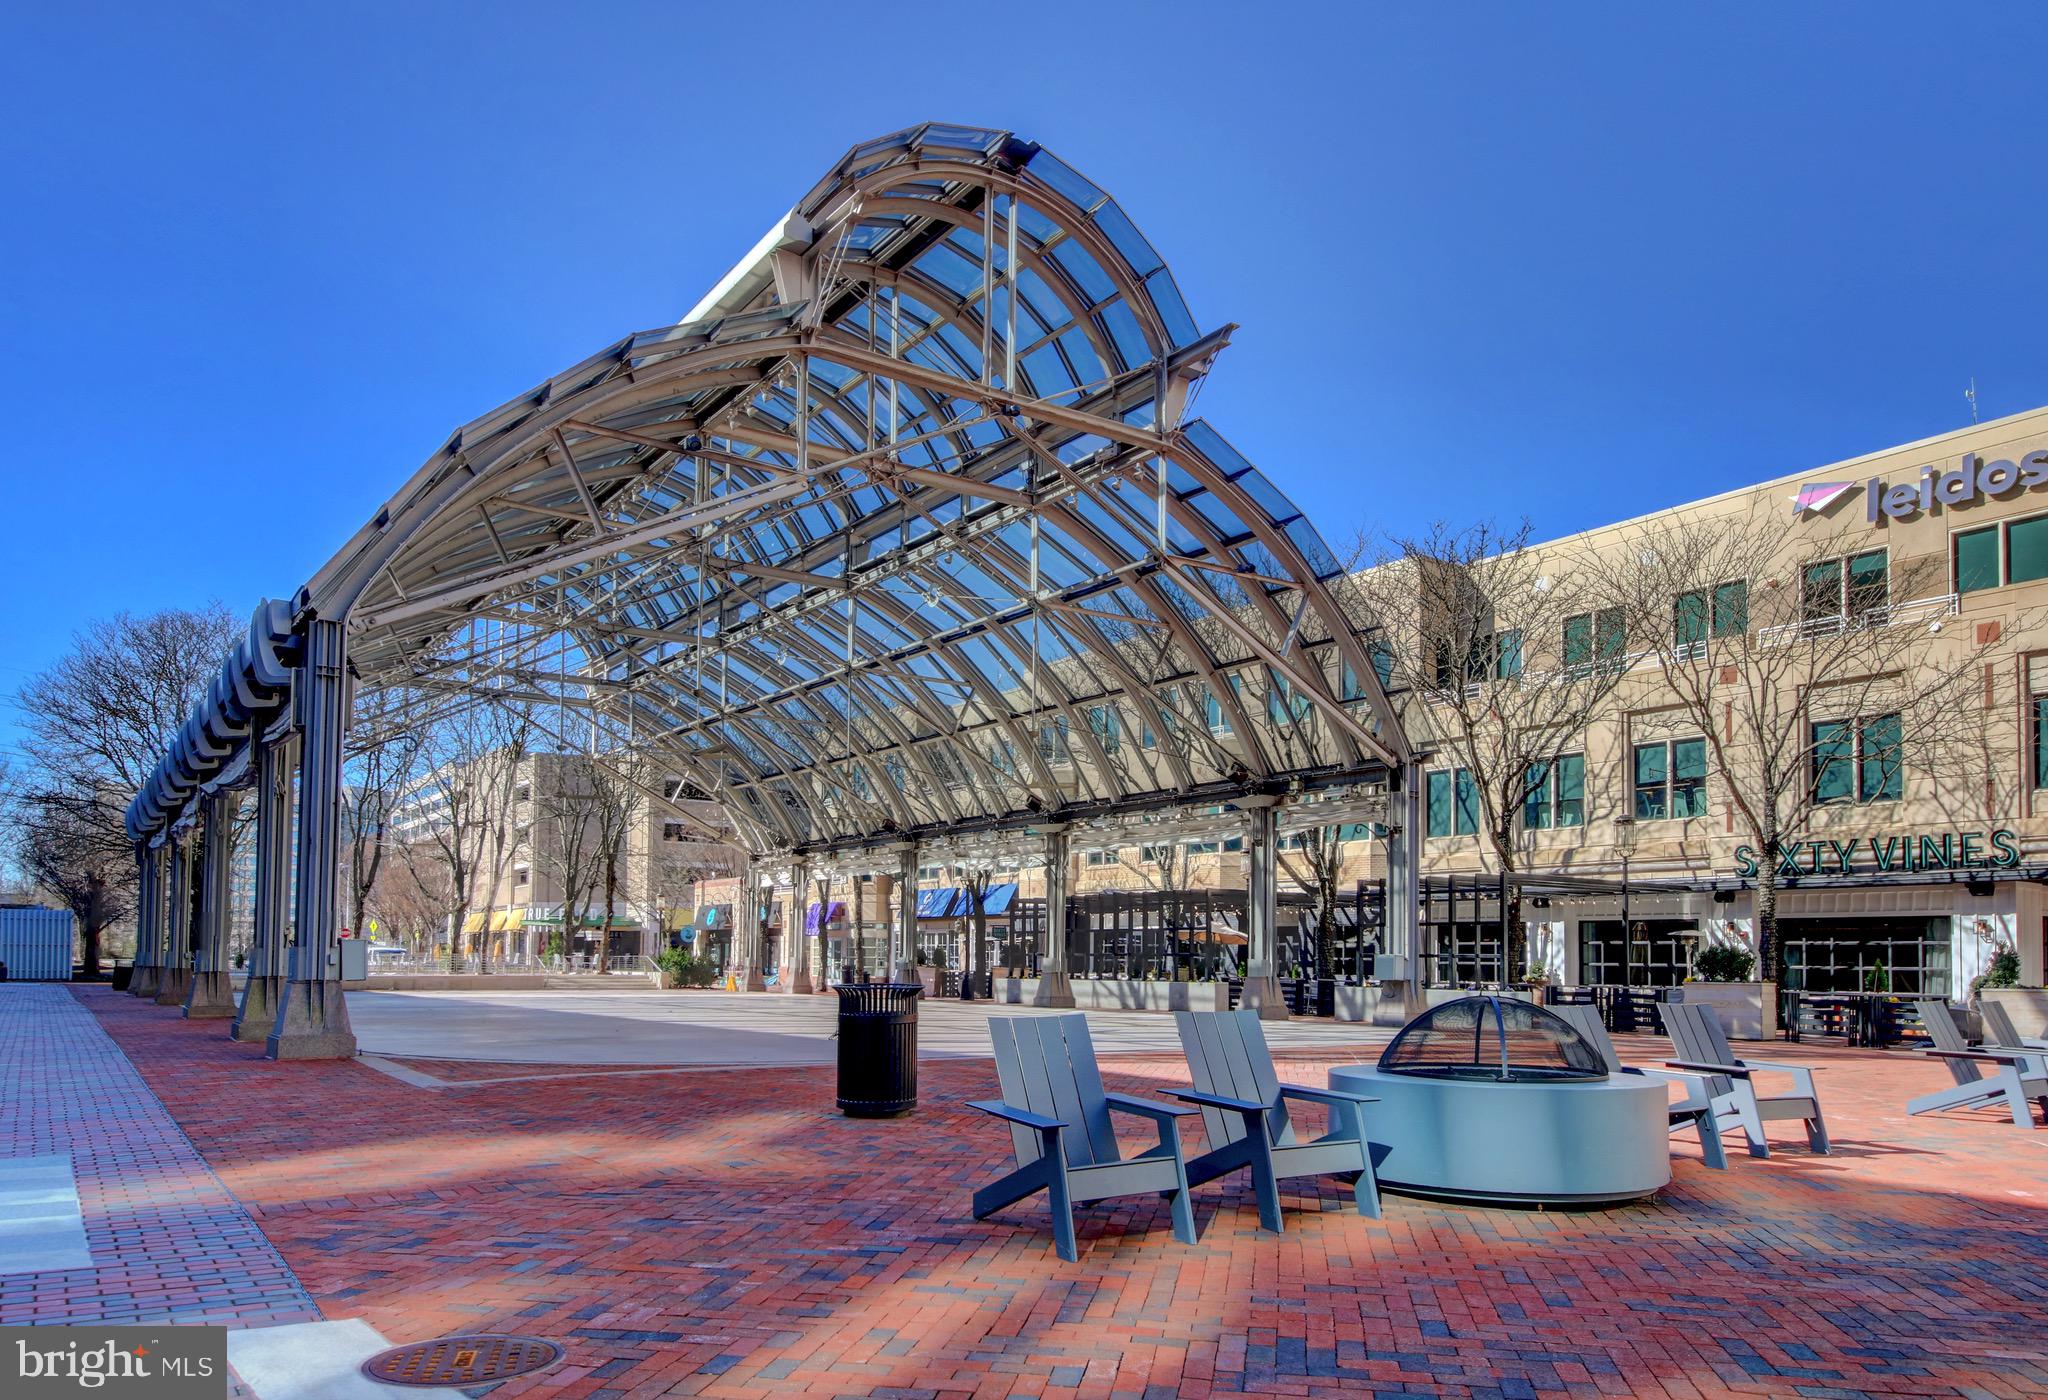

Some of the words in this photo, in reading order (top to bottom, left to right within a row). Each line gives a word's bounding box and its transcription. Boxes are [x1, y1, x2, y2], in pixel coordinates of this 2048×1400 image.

[1867, 450, 2048, 522] leidos
[1735, 838, 1858, 876] SXTY
[1870, 829, 2021, 872] VINES
[523, 907, 550, 921] TRUE
